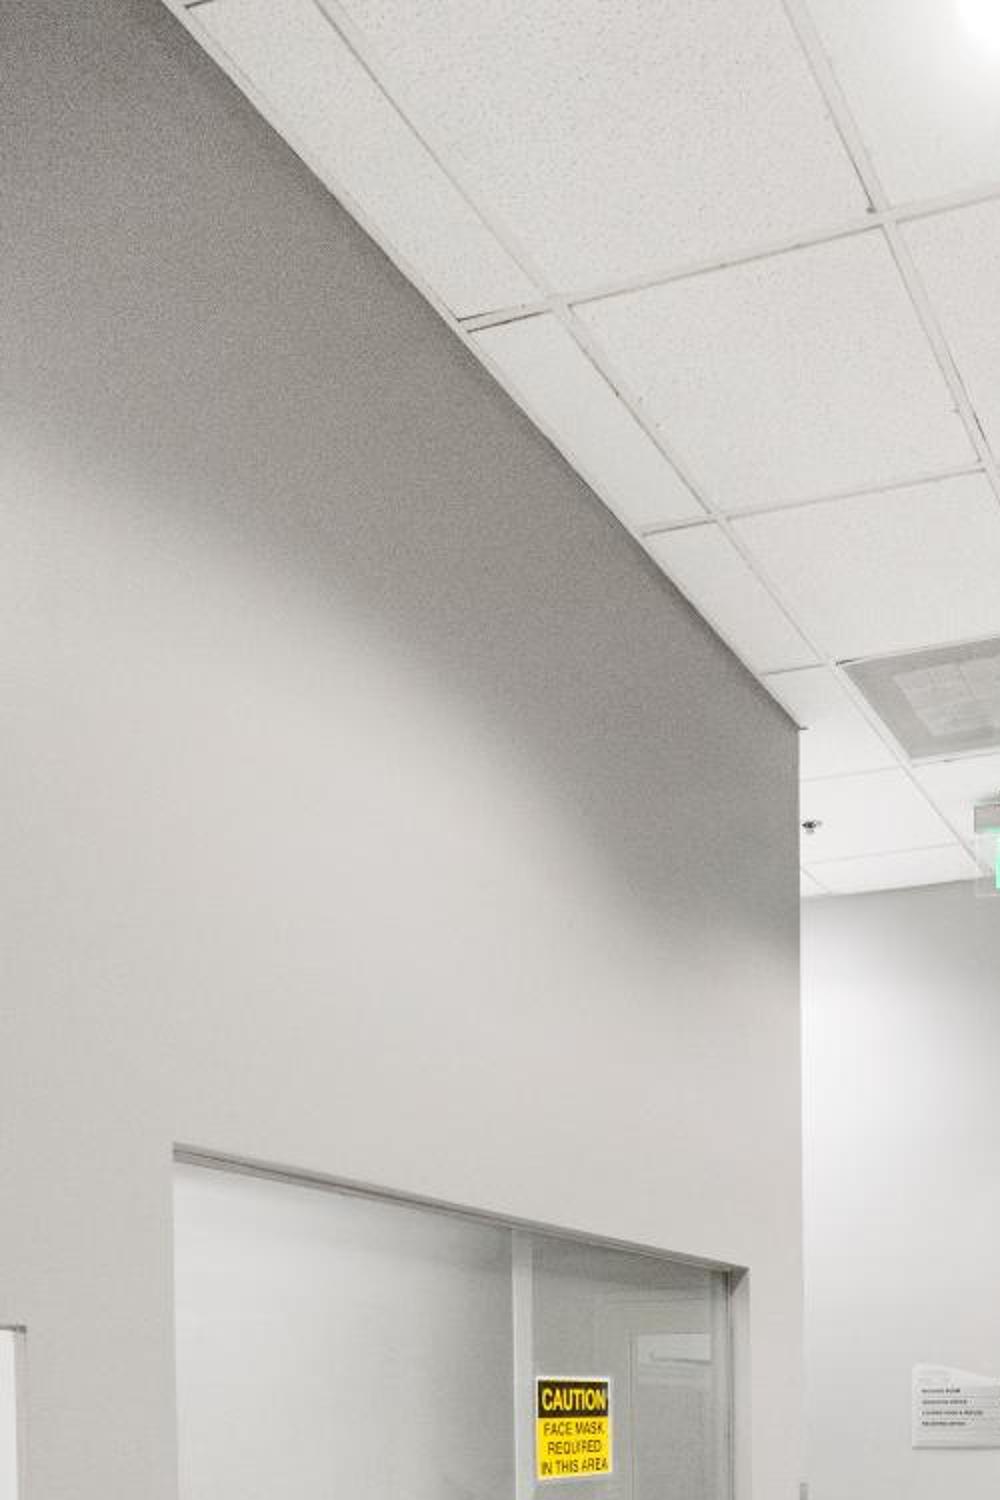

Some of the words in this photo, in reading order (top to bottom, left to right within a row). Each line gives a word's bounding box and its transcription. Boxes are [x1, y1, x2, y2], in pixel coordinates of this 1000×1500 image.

[542, 1387, 606, 1411] CAUTION
[543, 1422, 573, 1437] FACE
[576, 1421, 606, 1435] MASK
[547, 1440, 601, 1455] REQUIRED
[541, 1460, 552, 1476] IN
[555, 1459, 579, 1474] THIS
[582, 1457, 608, 1471] AREA
